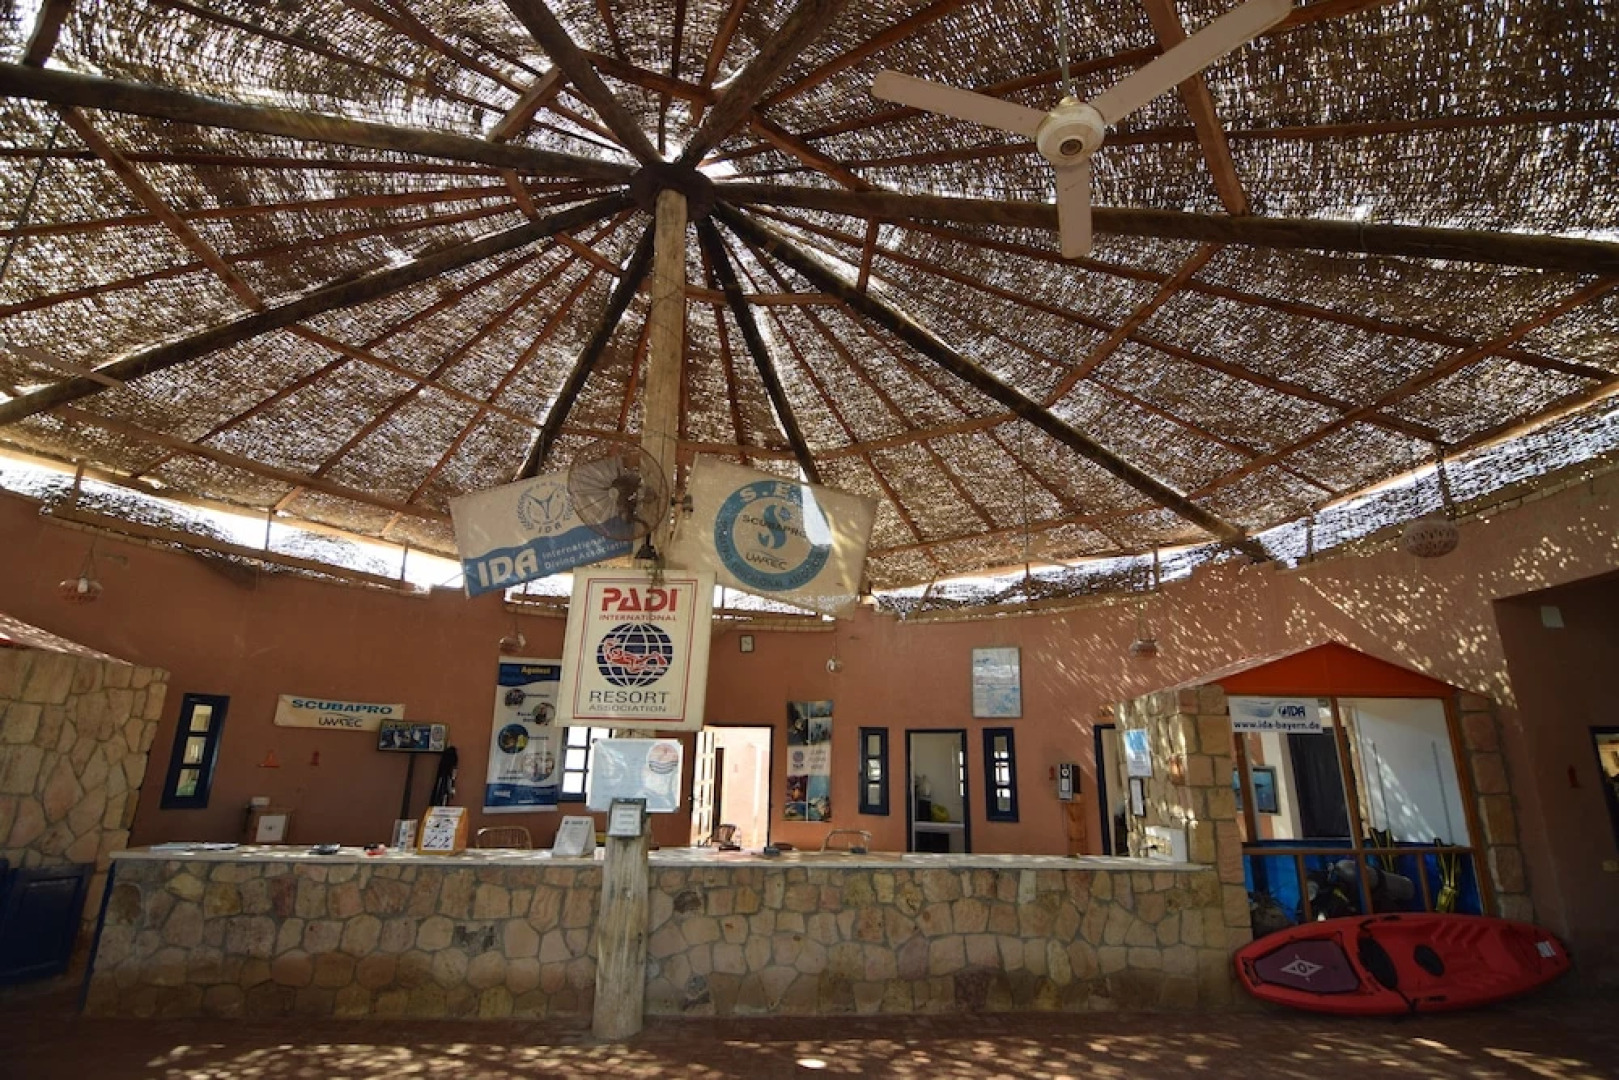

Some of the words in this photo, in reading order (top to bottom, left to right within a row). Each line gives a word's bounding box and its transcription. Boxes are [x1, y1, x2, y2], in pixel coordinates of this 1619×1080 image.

[542, 536, 606, 559] International
[477, 548, 539, 587] IDA
[544, 555, 576, 570] Diving
[602, 587, 678, 612] PADI
[599, 613, 677, 621] INTERNATIONAL
[589, 690, 670, 704] RESORT
[291, 699, 393, 715] SCUBAPRO
[589, 703, 667, 713] ASSOCIATION
[1233, 720, 1320, 731] www.ida-bayern.de
